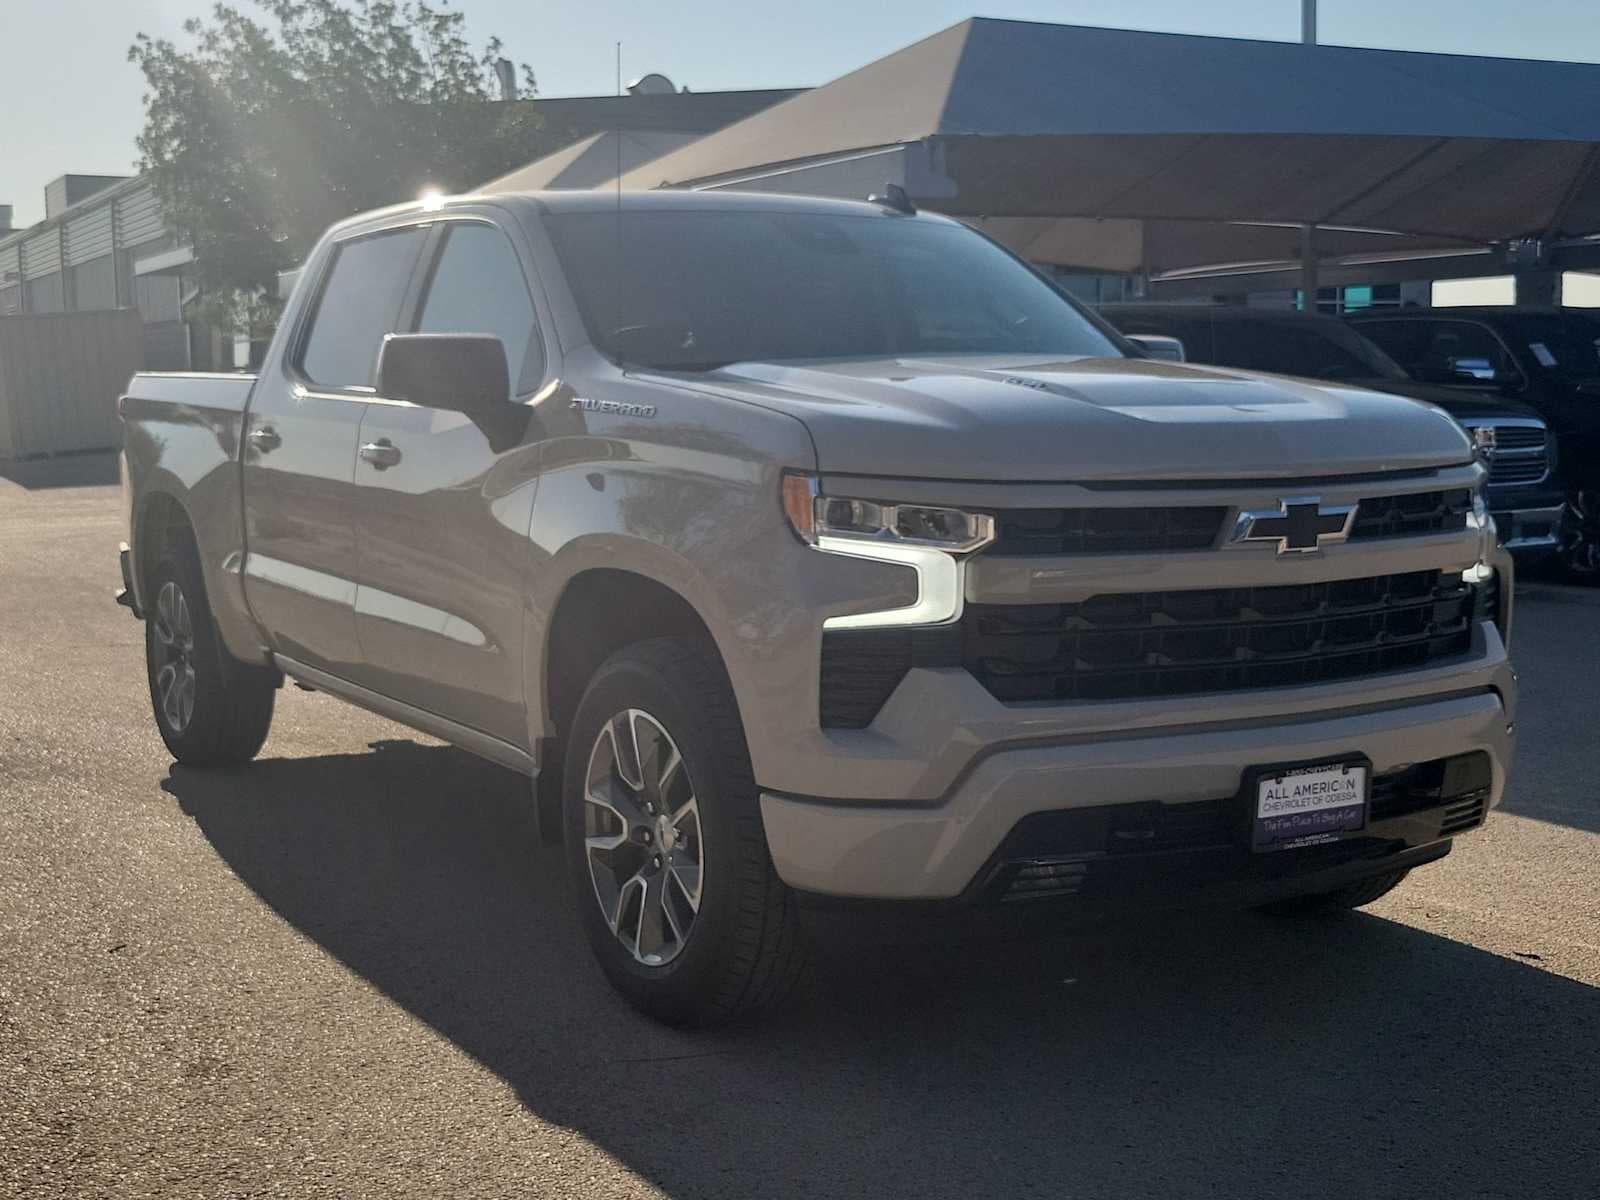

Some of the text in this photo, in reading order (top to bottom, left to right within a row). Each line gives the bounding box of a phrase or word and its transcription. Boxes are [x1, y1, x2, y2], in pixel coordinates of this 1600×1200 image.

[1263, 791, 1357, 812] CHEVROLET OF ODESSA
[1266, 787, 1288, 800] ALL
